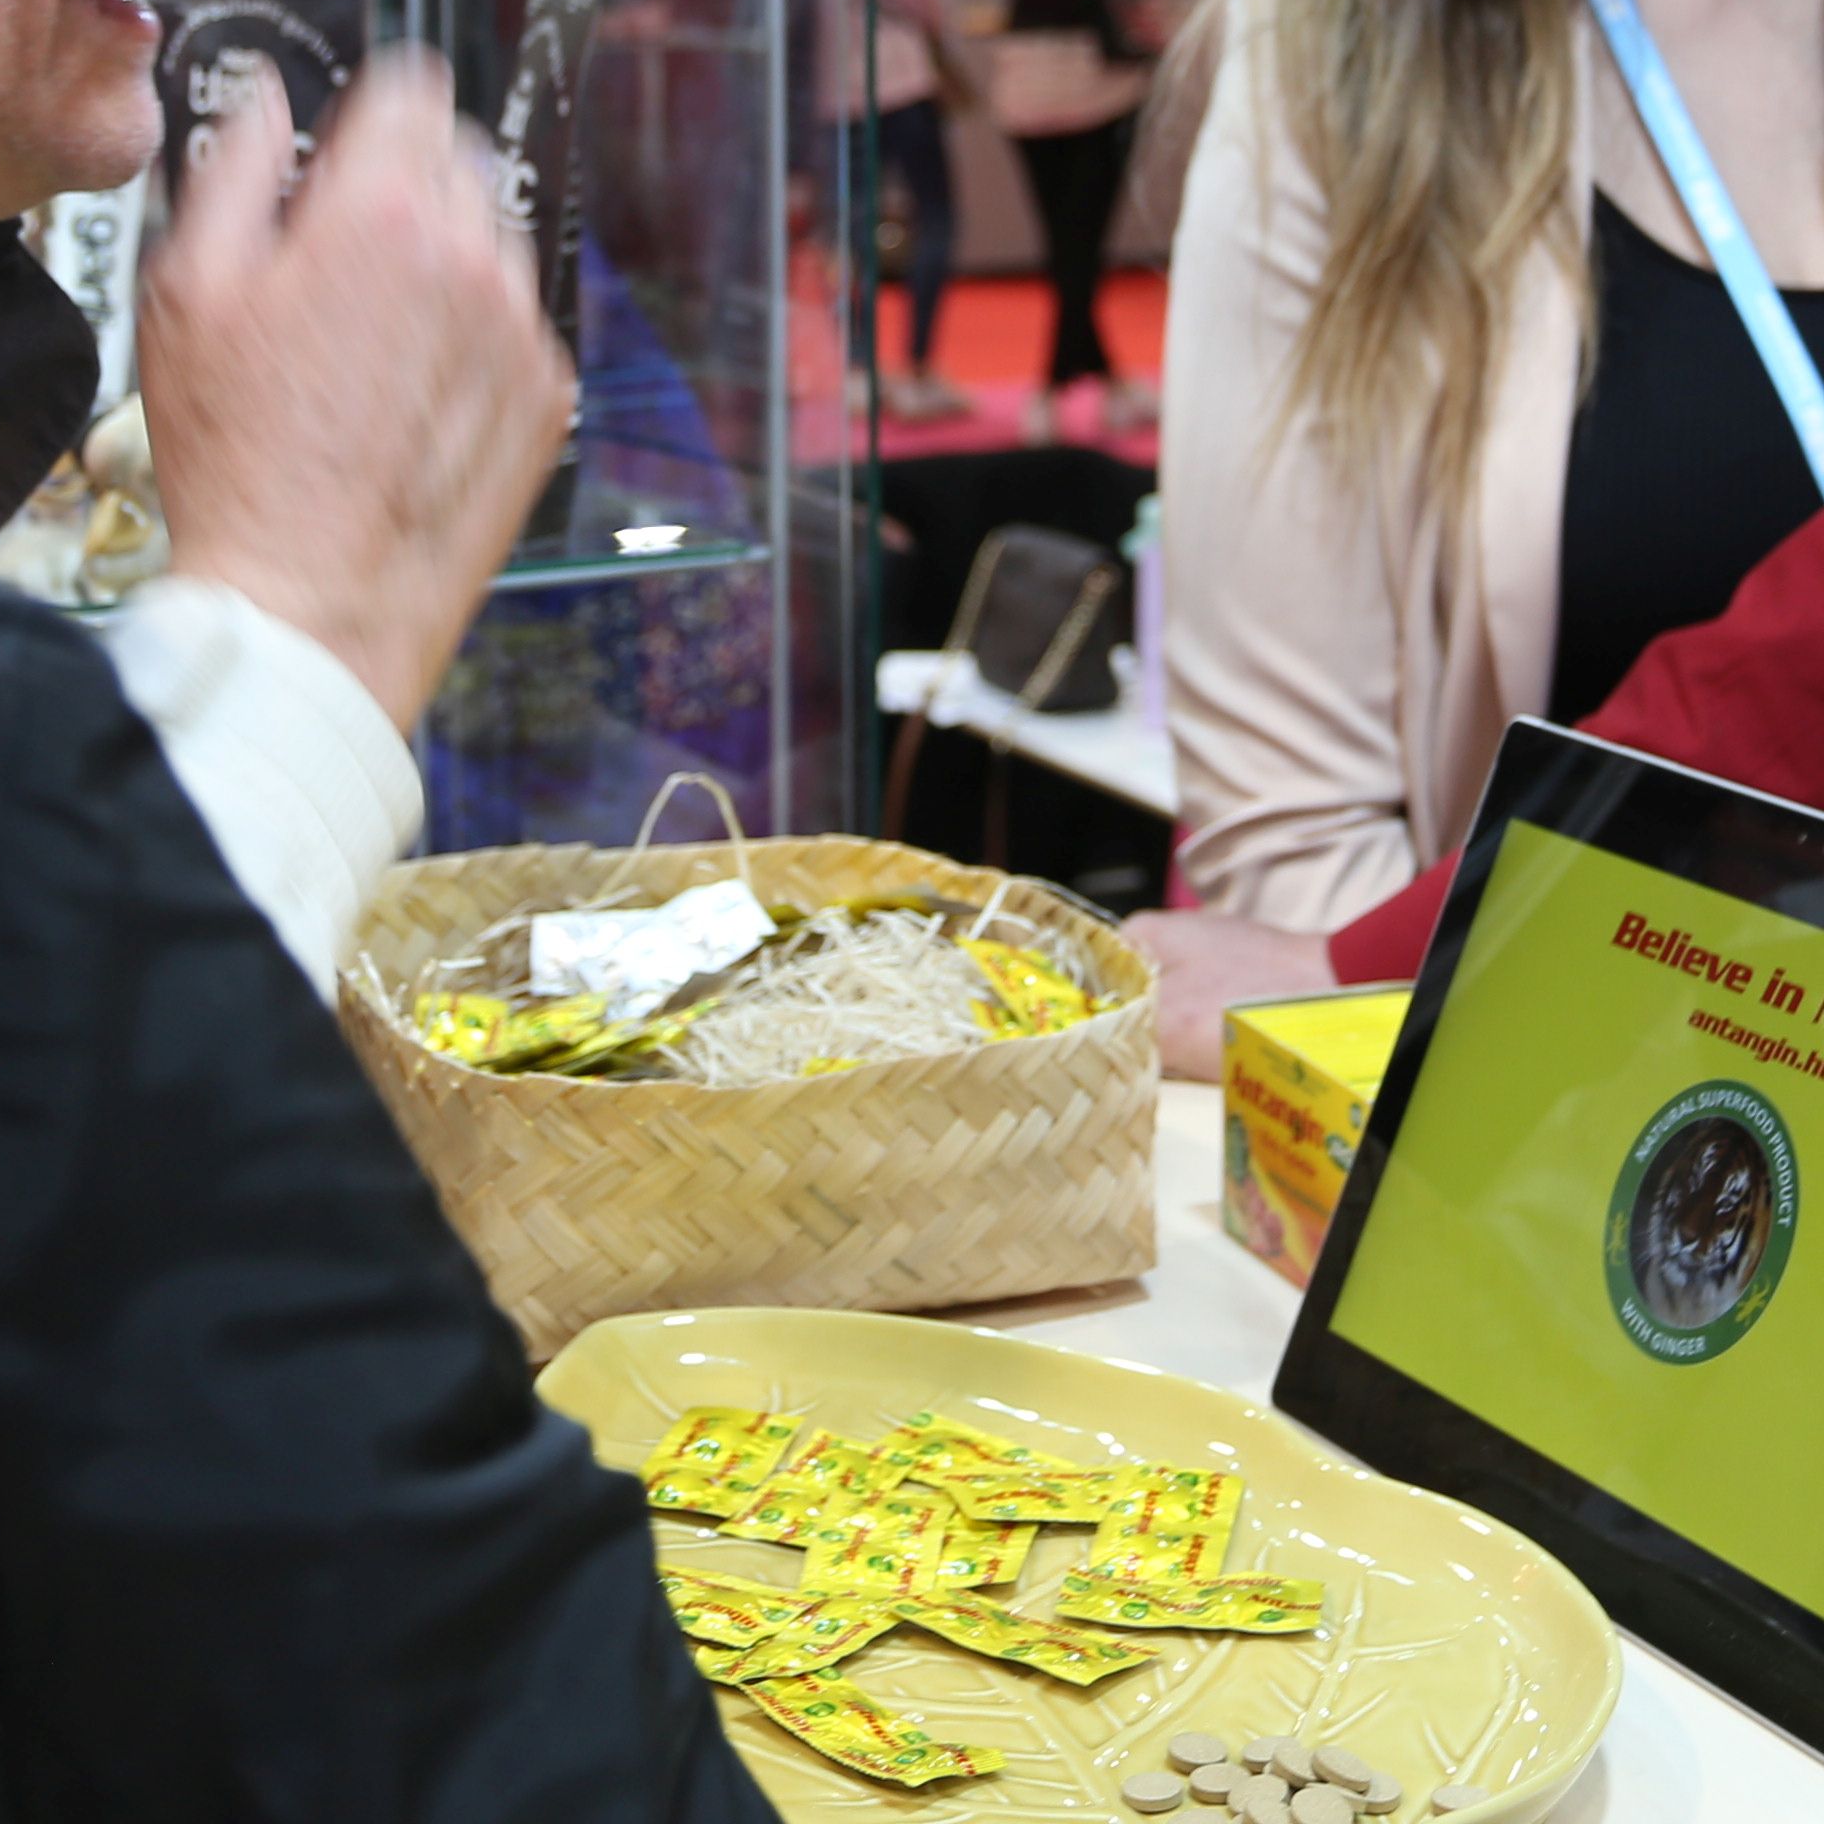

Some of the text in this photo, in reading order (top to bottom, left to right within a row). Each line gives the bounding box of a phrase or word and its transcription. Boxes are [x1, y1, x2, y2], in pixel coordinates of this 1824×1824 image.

[1611, 910, 1754, 994] Believe
[1760, 967, 1807, 1015] in
[1635, 1088, 1795, 1228] NATURAL SUPERFOOD PRODUCT
[1620, 1297, 1707, 1358] WITH GINGER
